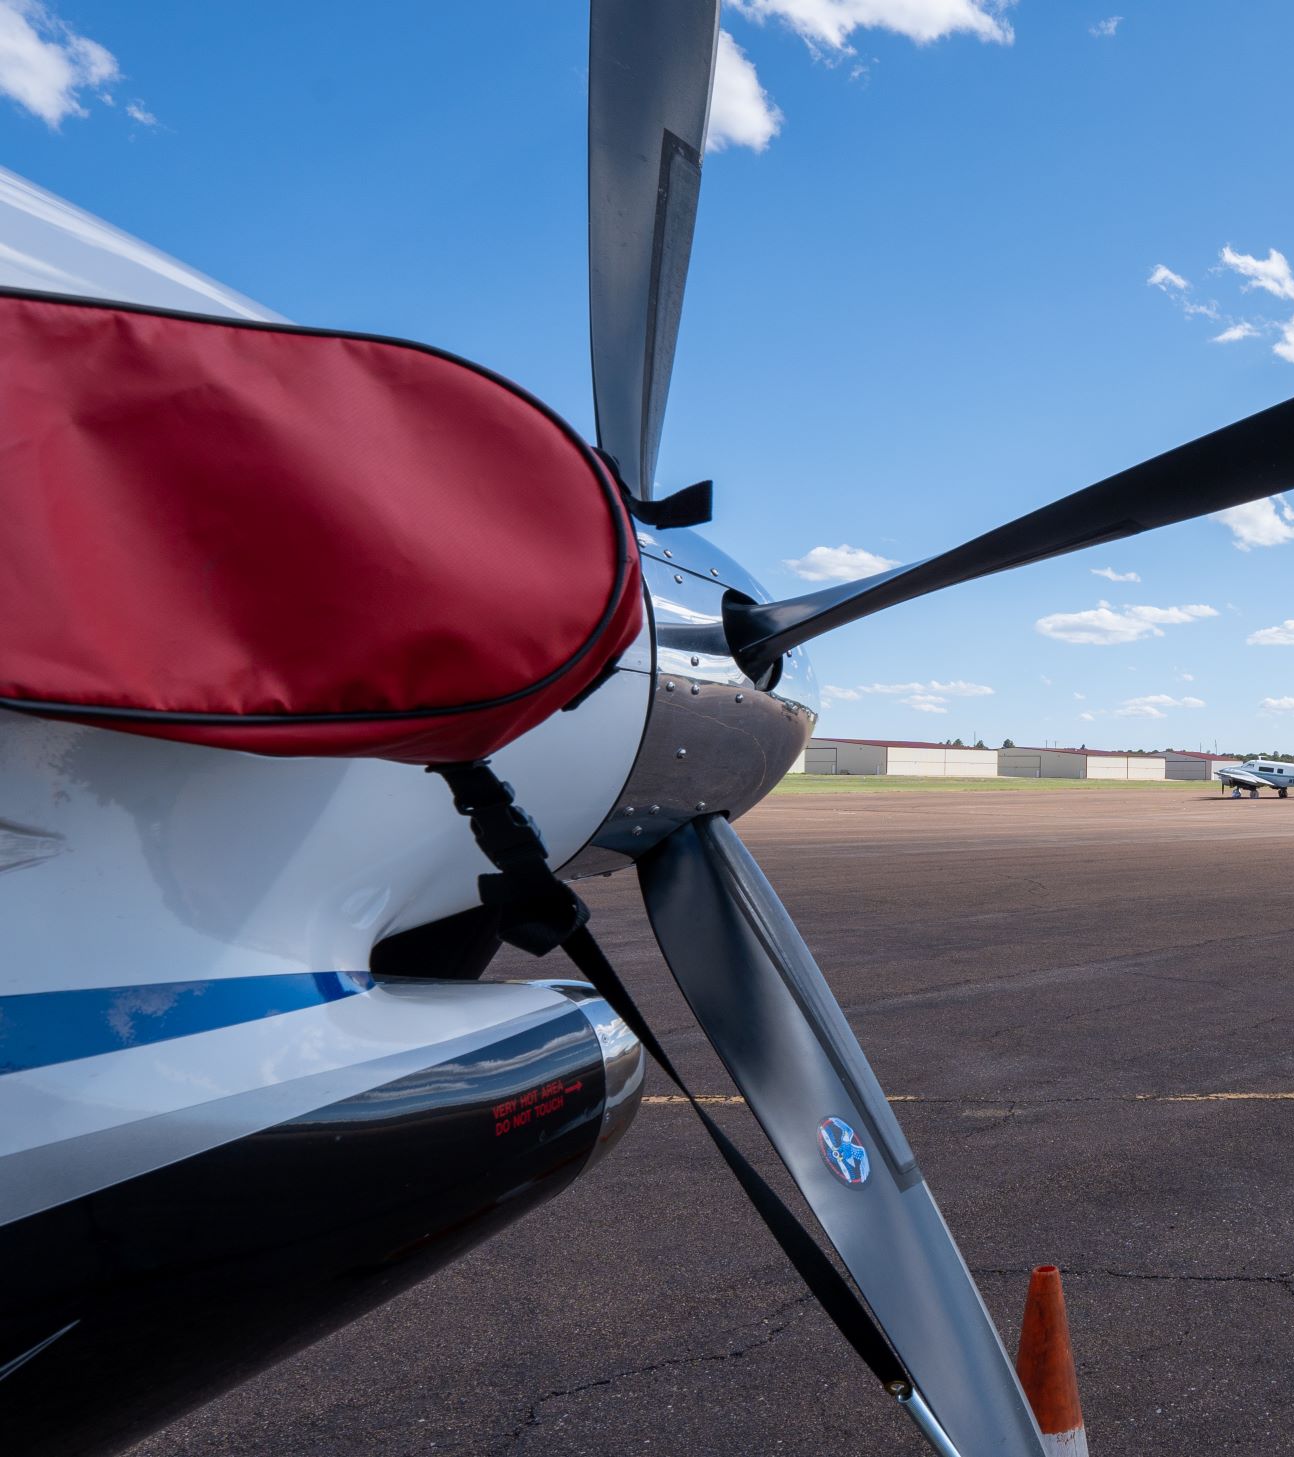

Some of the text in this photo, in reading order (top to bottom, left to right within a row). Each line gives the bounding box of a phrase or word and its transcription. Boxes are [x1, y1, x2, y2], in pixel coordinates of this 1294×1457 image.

[492, 1080, 564, 1120] VERY HOT AREA
[495, 1095, 564, 1137] DO NOT TOUCH
